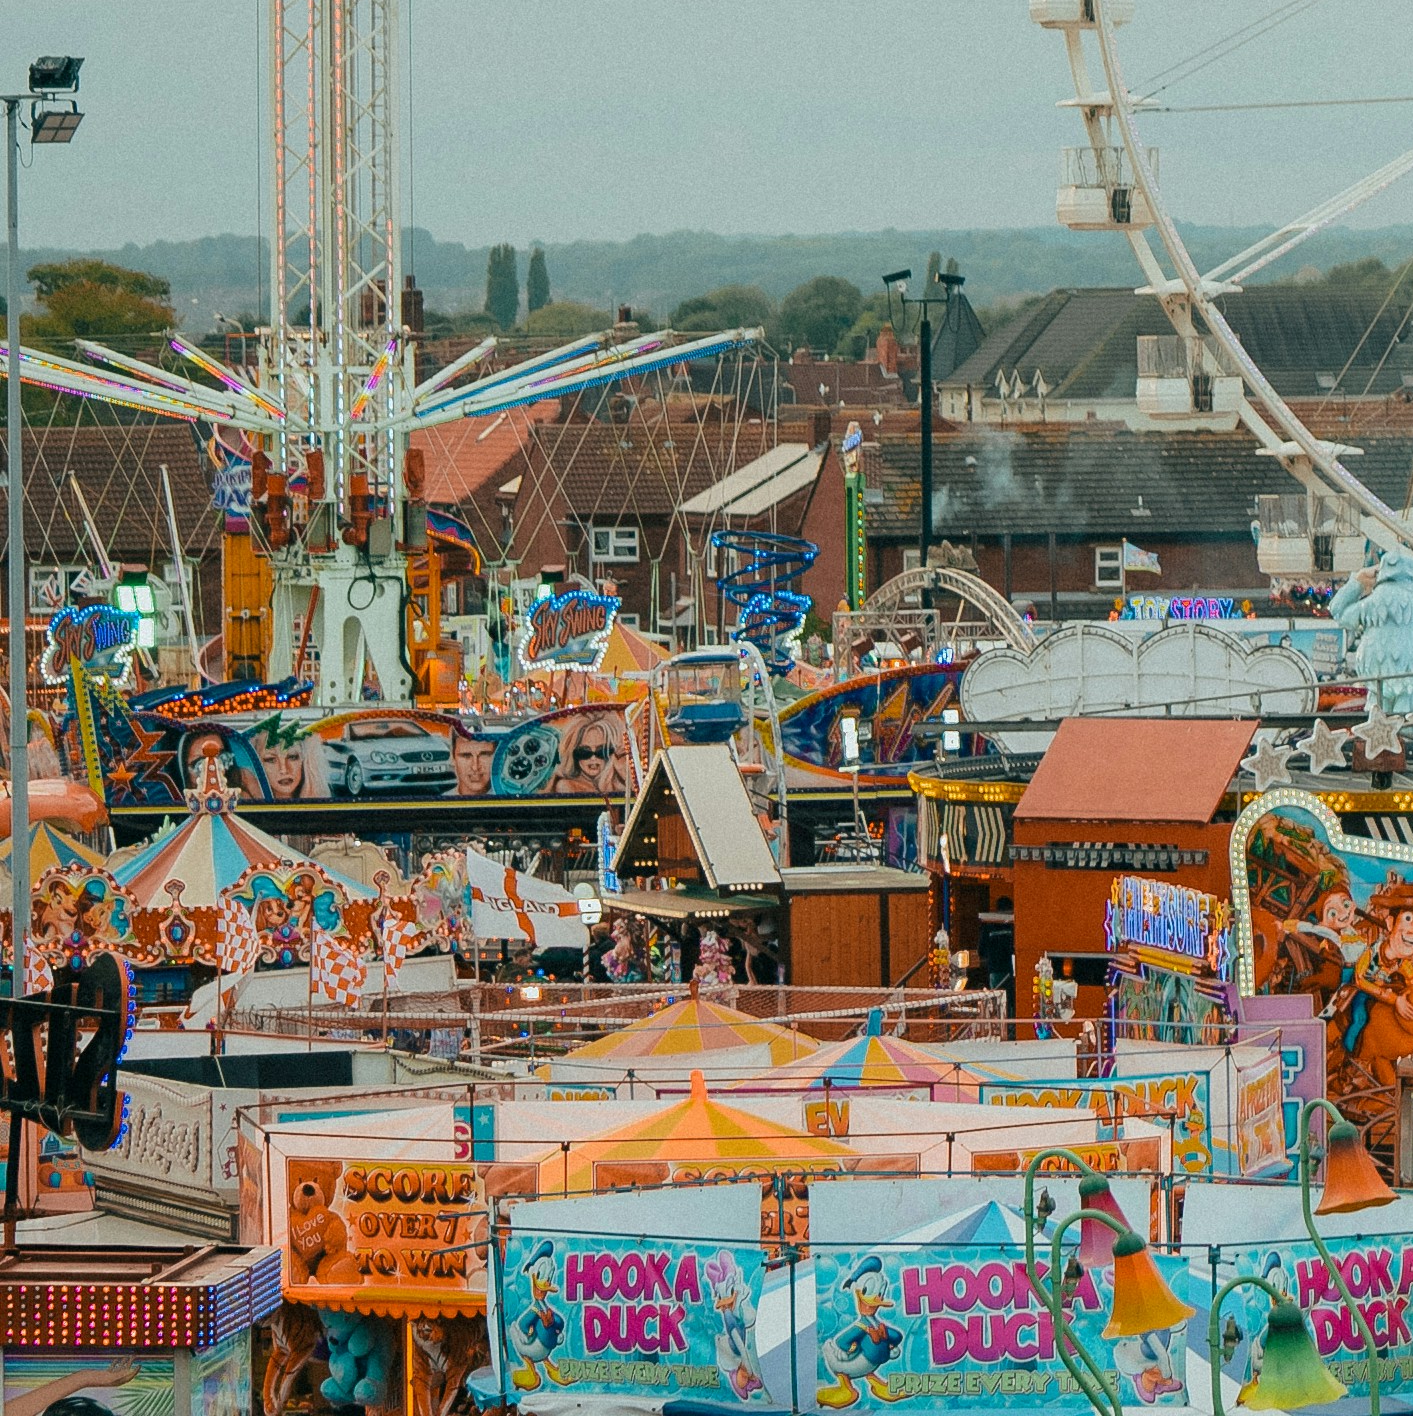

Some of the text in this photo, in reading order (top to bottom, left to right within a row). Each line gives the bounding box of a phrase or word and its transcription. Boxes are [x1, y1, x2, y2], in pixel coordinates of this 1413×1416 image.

[1169, 595, 1235, 621] STORY
[342, 1164, 478, 1204] SCORE
[358, 1209, 460, 1245] OVER 7
[354, 1246, 468, 1280] TO WIN
[565, 1251, 702, 1303] HOOK A
[1294, 1247, 1395, 1310] HOOK
[902, 1260, 1052, 1316] HOOK
[583, 1303, 689, 1355] DUCK
[928, 1311, 1082, 1367] DUCK
[1310, 1296, 1413, 1357] DUCK
[557, 1358, 721, 1389] PRIZE EVERY TIME
[887, 1370, 963, 1396] PRIZE
[965, 1369, 1054, 1396] EVERY
